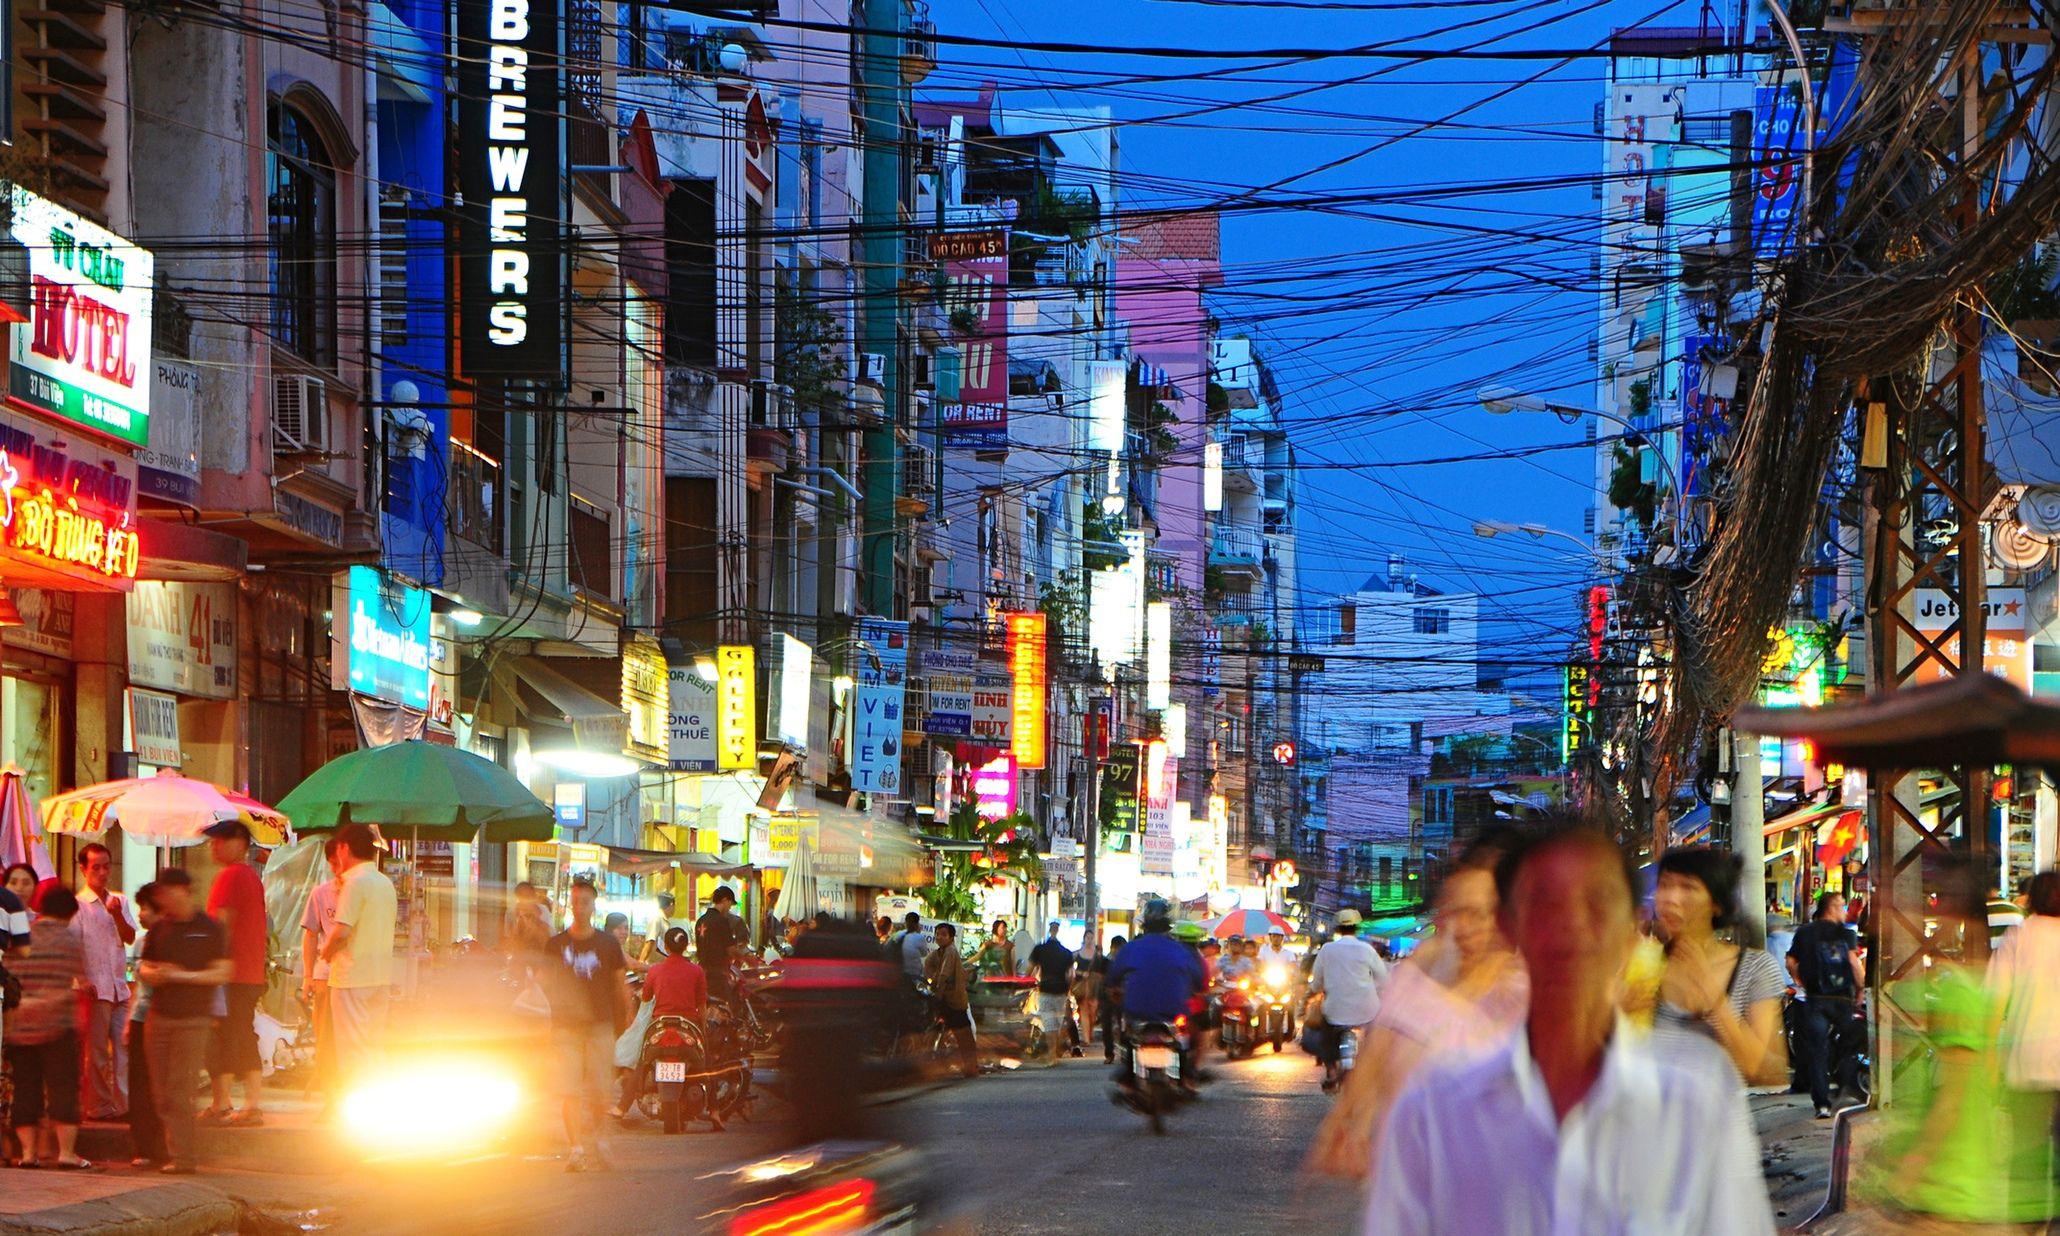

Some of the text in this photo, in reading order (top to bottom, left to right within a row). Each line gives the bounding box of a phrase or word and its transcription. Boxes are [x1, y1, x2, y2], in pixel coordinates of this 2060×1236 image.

[488, 0, 529, 345] BREWERS
[31, 273, 136, 389] HOTEL
[966, 402, 1003, 420] RENT
[1920, 599, 2001, 618] Jetar
[189, 592, 212, 666] 41
[686, 673, 715, 696] RENT
[726, 649, 746, 764] GALLERY
[671, 726, 710, 740] THUÊ
[1110, 763, 1134, 782] 97
[1149, 811, 1165, 821] 103
